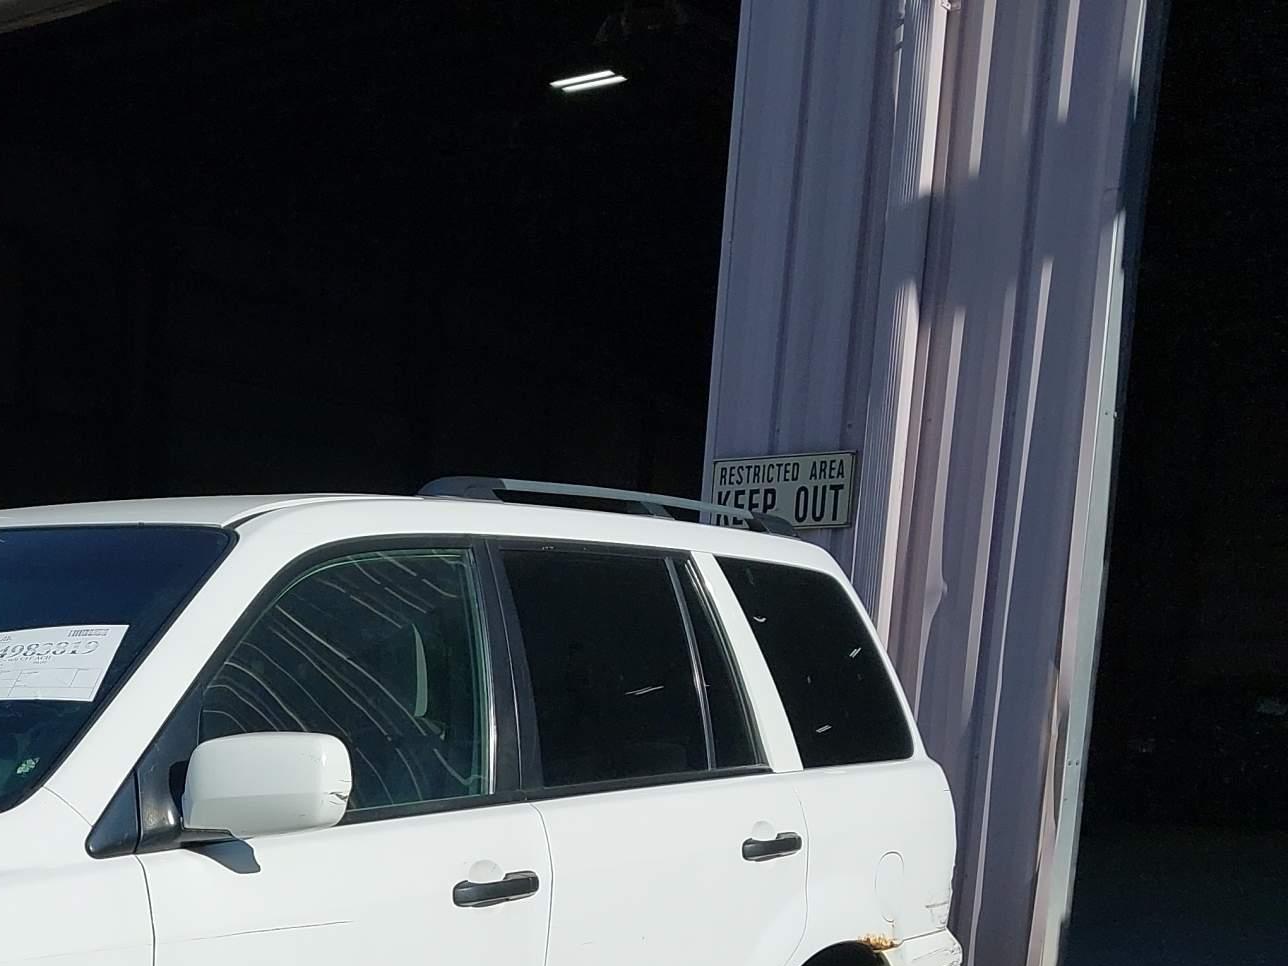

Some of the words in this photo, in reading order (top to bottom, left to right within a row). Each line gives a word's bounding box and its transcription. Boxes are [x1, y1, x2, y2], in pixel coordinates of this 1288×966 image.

[719, 462, 800, 486] RESTRICTED
[809, 459, 845, 481] AREA
[794, 484, 845, 523] OUT
